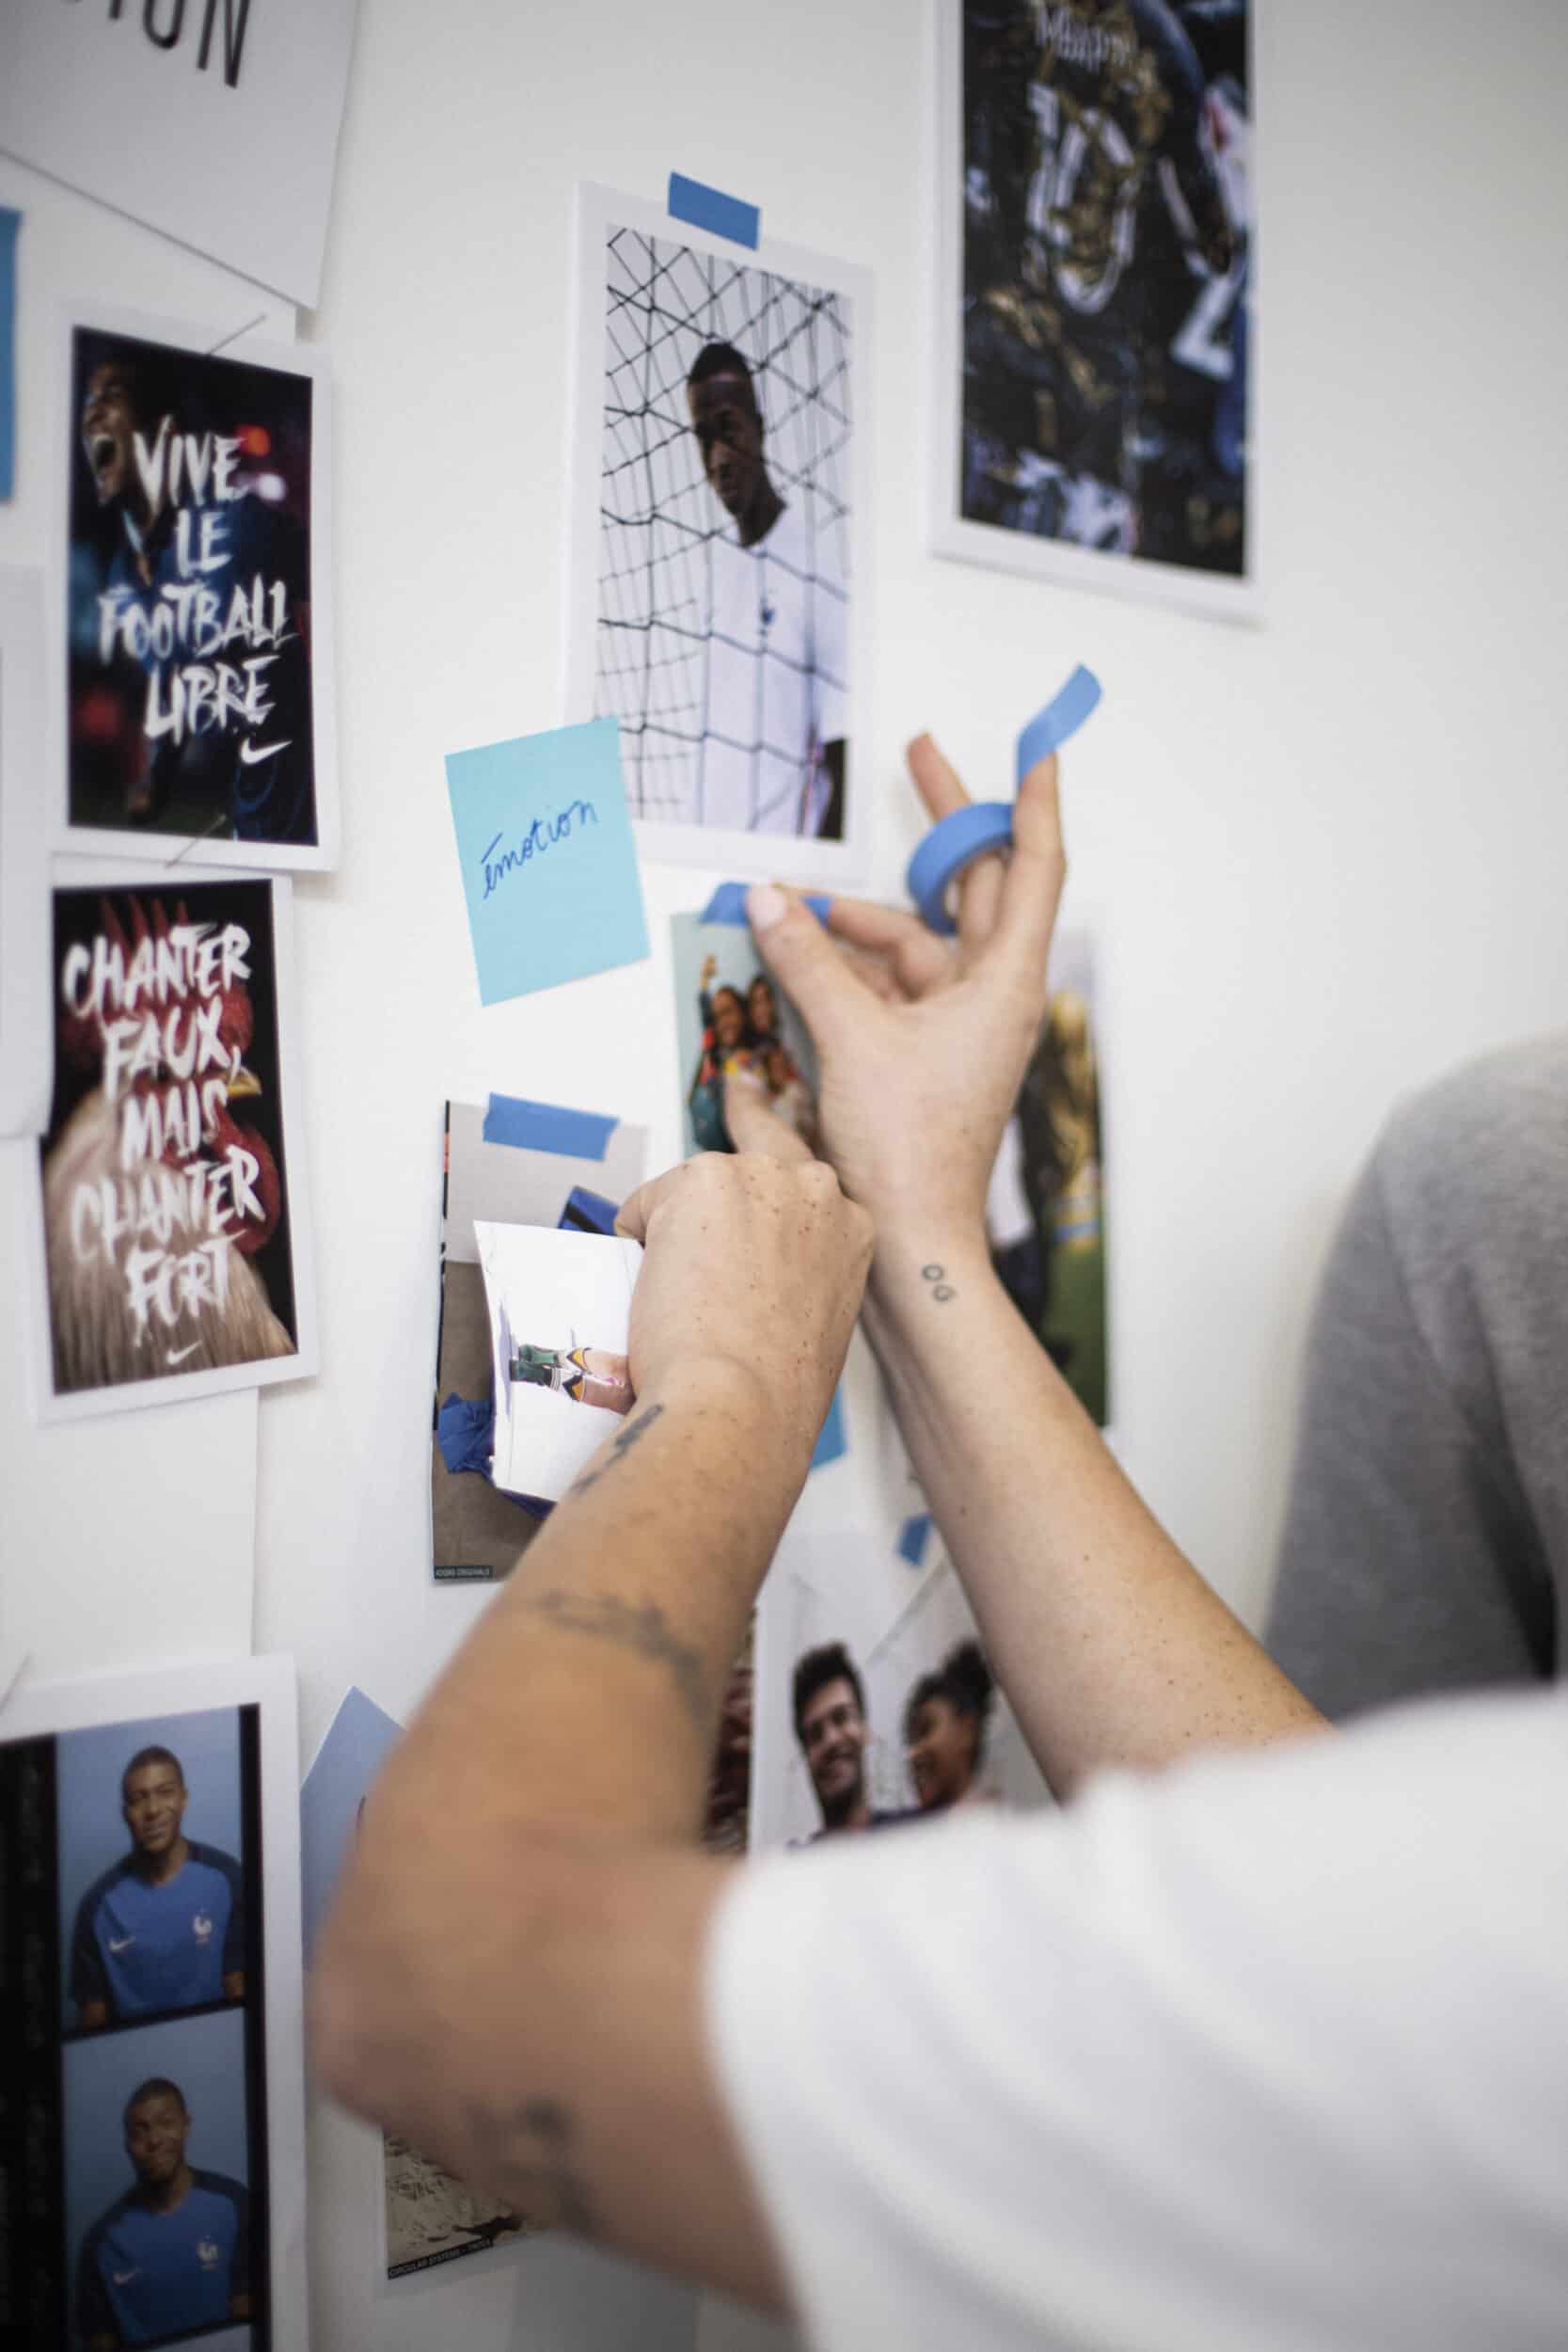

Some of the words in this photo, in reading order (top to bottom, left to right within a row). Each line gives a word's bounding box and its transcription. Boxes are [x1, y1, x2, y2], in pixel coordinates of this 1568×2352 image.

[133, 414, 248, 511] VIVE
[176, 508, 231, 578] LE
[98, 573, 300, 666] FOOTBALL
[144, 655, 280, 746] LIBRE
[481, 800, 598, 899] émotion
[62, 922, 251, 1020] CHANTER
[121, 1081, 228, 1171] MAIS
[70, 1145, 265, 1264] CHANTER
[125, 1230, 246, 1340] FORT
